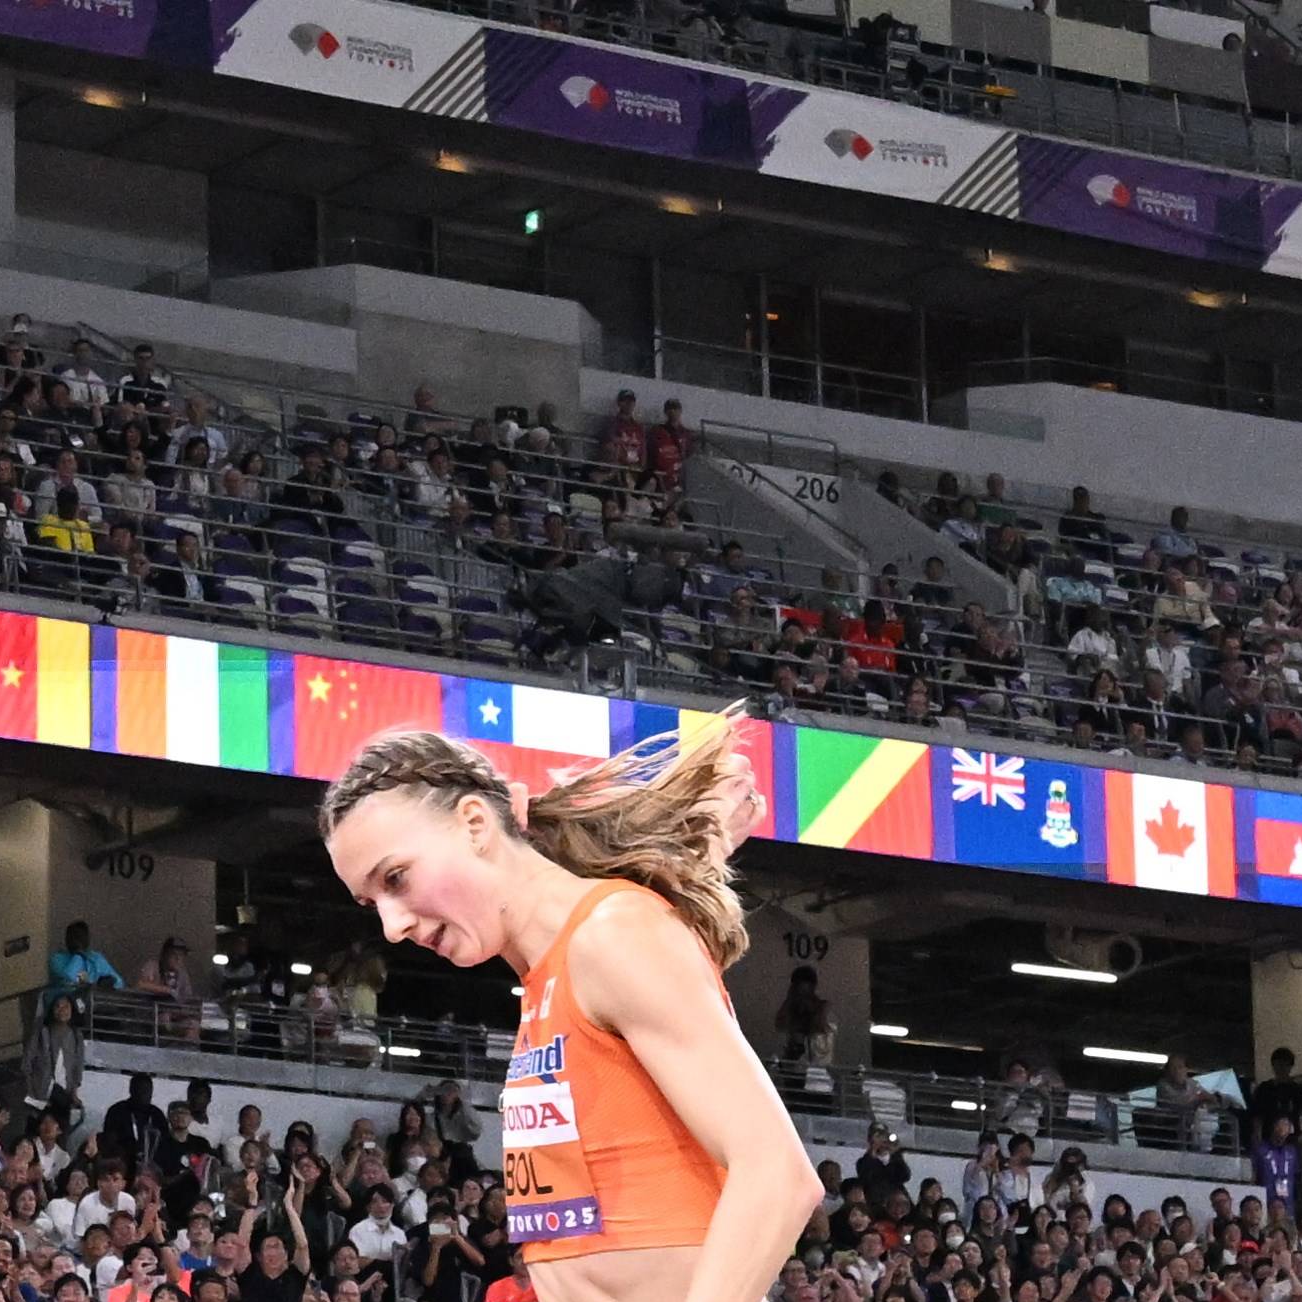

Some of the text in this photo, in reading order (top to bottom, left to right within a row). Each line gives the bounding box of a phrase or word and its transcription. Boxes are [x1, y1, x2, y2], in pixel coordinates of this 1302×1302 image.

[795, 475, 840, 505] 206
[106, 850, 155, 882] 109
[783, 931, 829, 961] 109
[503, 1101, 570, 1132] ONDA
[506, 1152, 554, 1197] BOL
